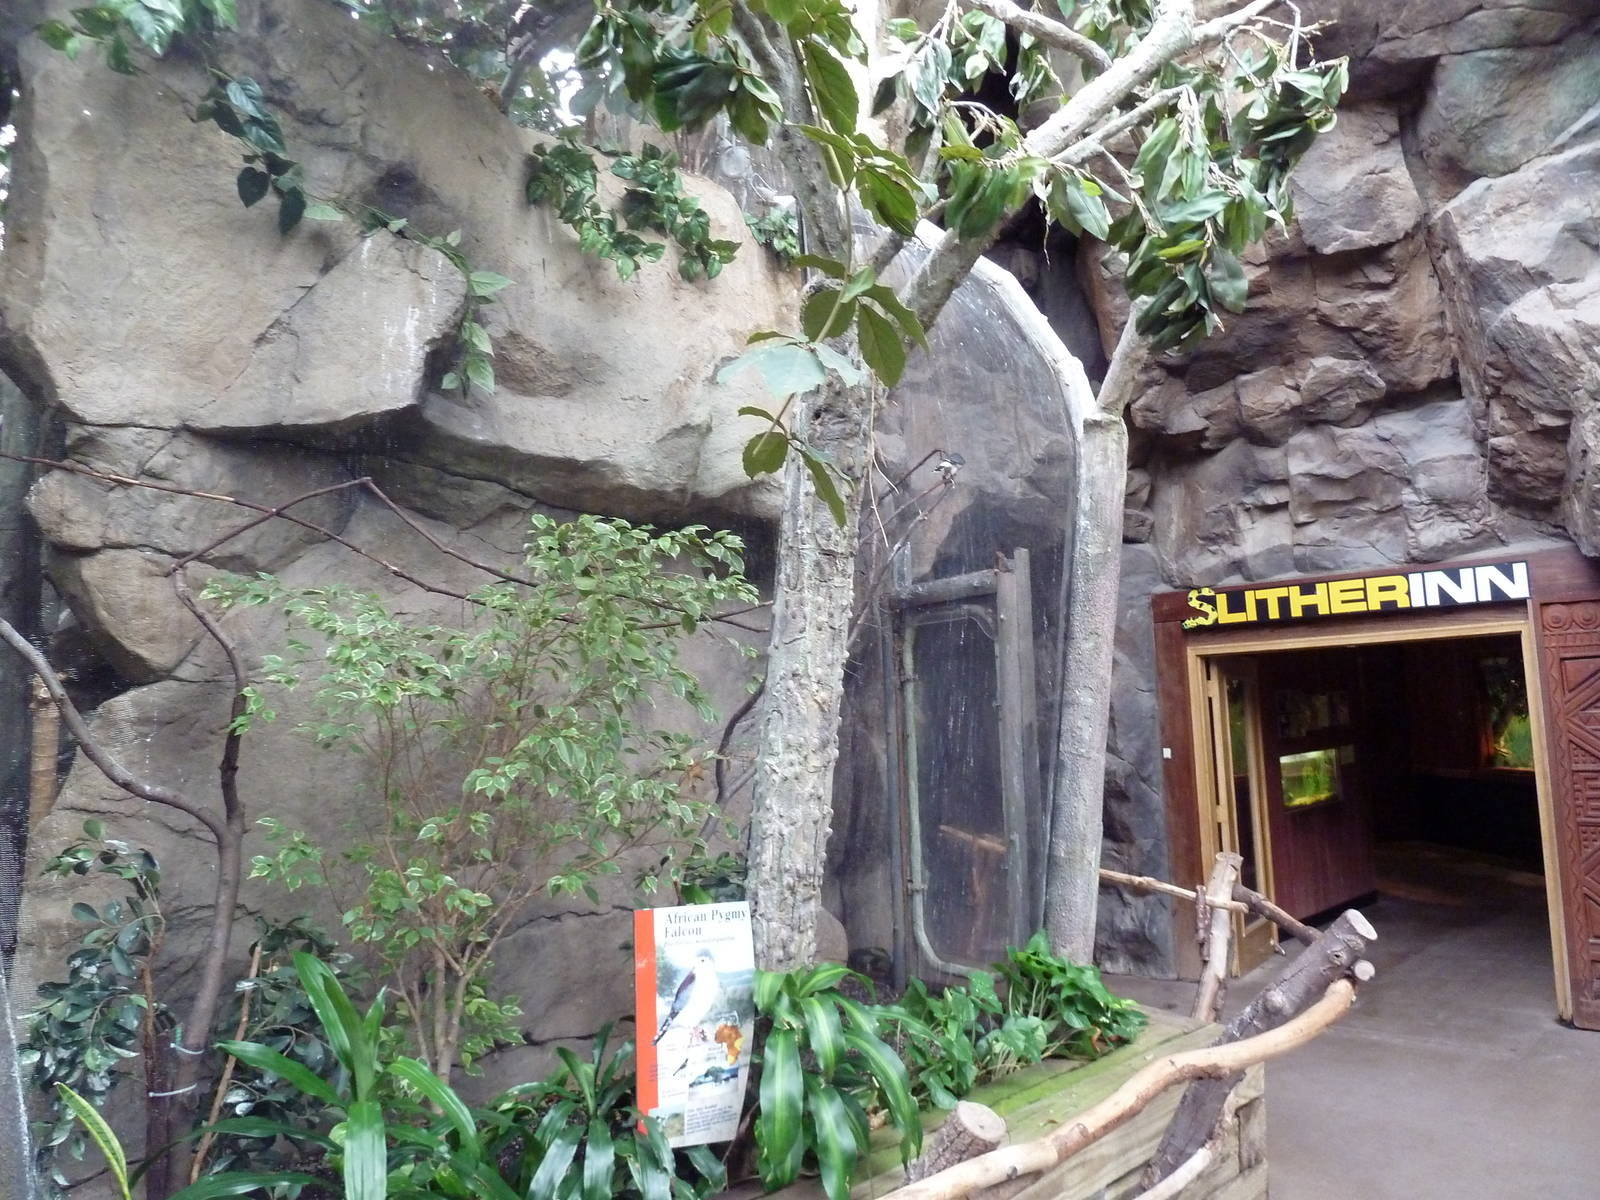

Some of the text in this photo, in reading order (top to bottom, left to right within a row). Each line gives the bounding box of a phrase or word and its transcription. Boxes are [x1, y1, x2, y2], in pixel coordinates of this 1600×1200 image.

[666, 909, 747, 924] African Pygmy
[664, 926, 702, 938] Falcon
